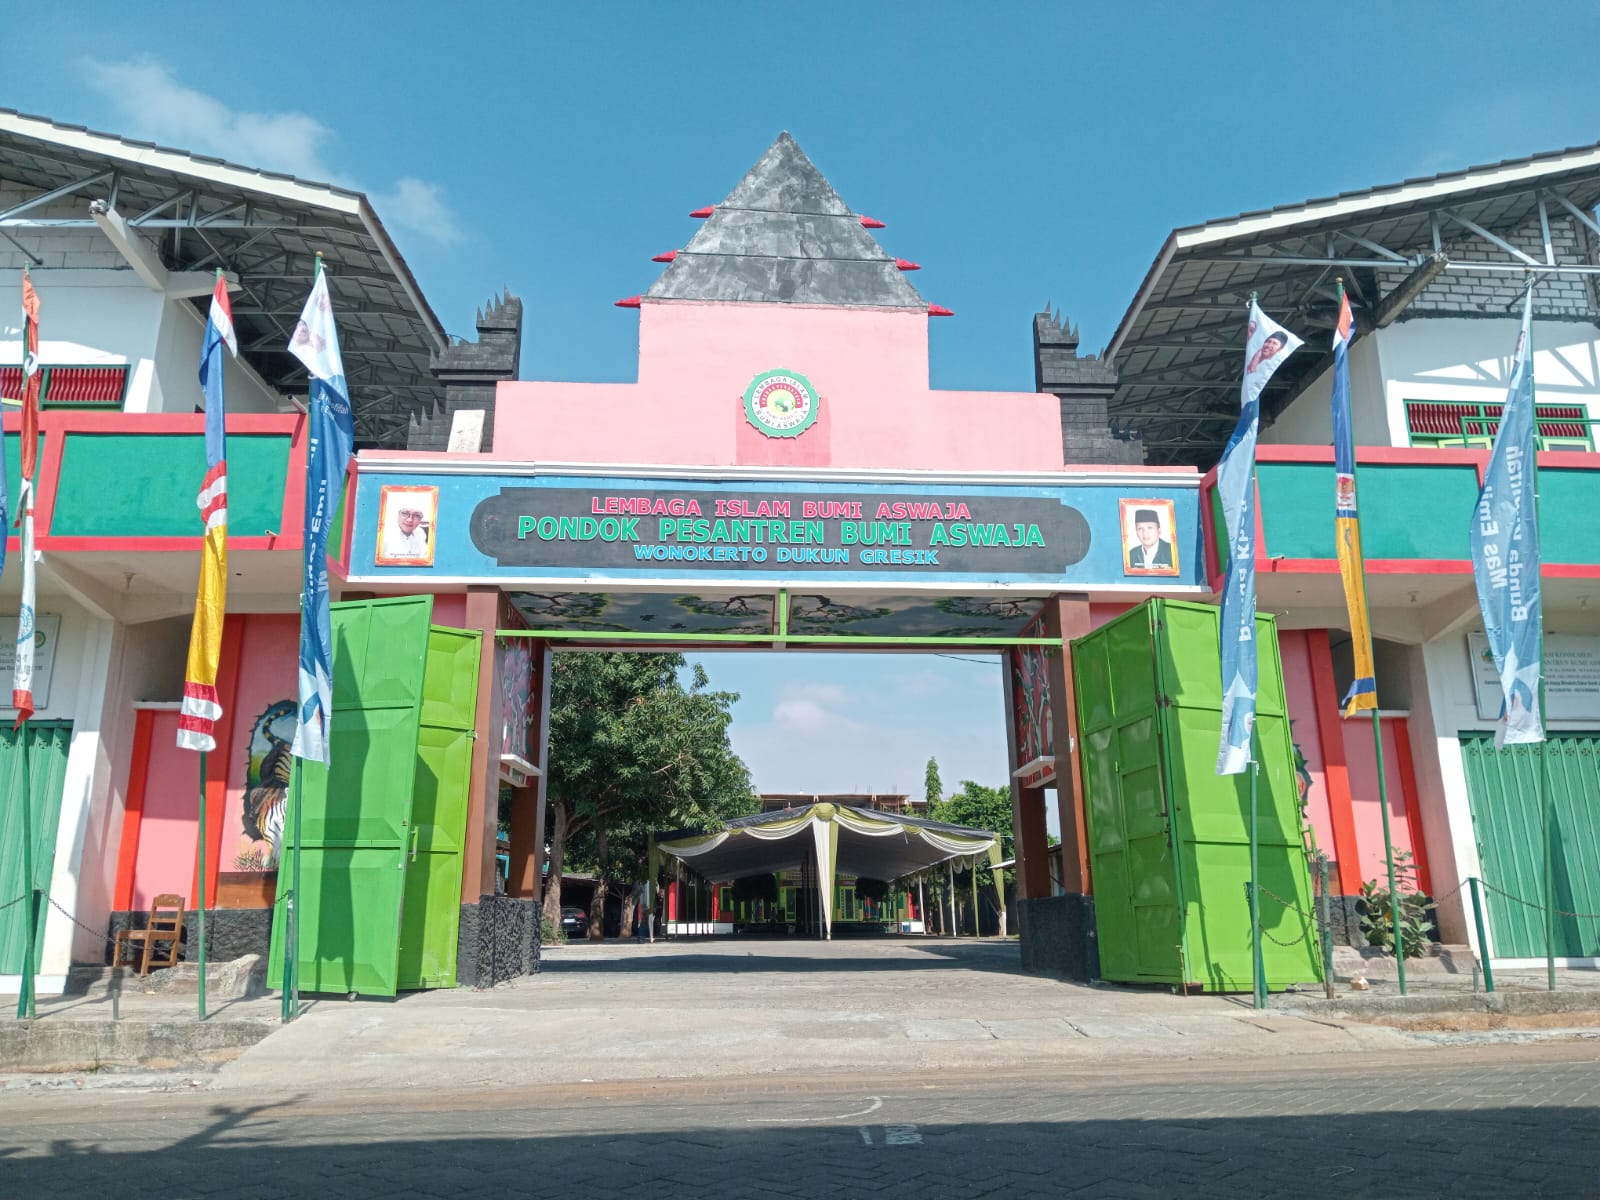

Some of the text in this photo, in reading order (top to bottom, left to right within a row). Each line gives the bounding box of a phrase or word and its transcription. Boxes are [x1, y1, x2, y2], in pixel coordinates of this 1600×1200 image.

[754, 376, 787, 399] LEMBAGA
[756, 410, 775, 426] BUMI
[592, 496, 972, 520] LEMBAGA ISLAM BUMI ASWAJA
[518, 515, 1046, 548] PONDOK PESANTREN BUMI ASWAJA
[633, 544, 939, 565] WONOKERTO DUKUN GRESIK
